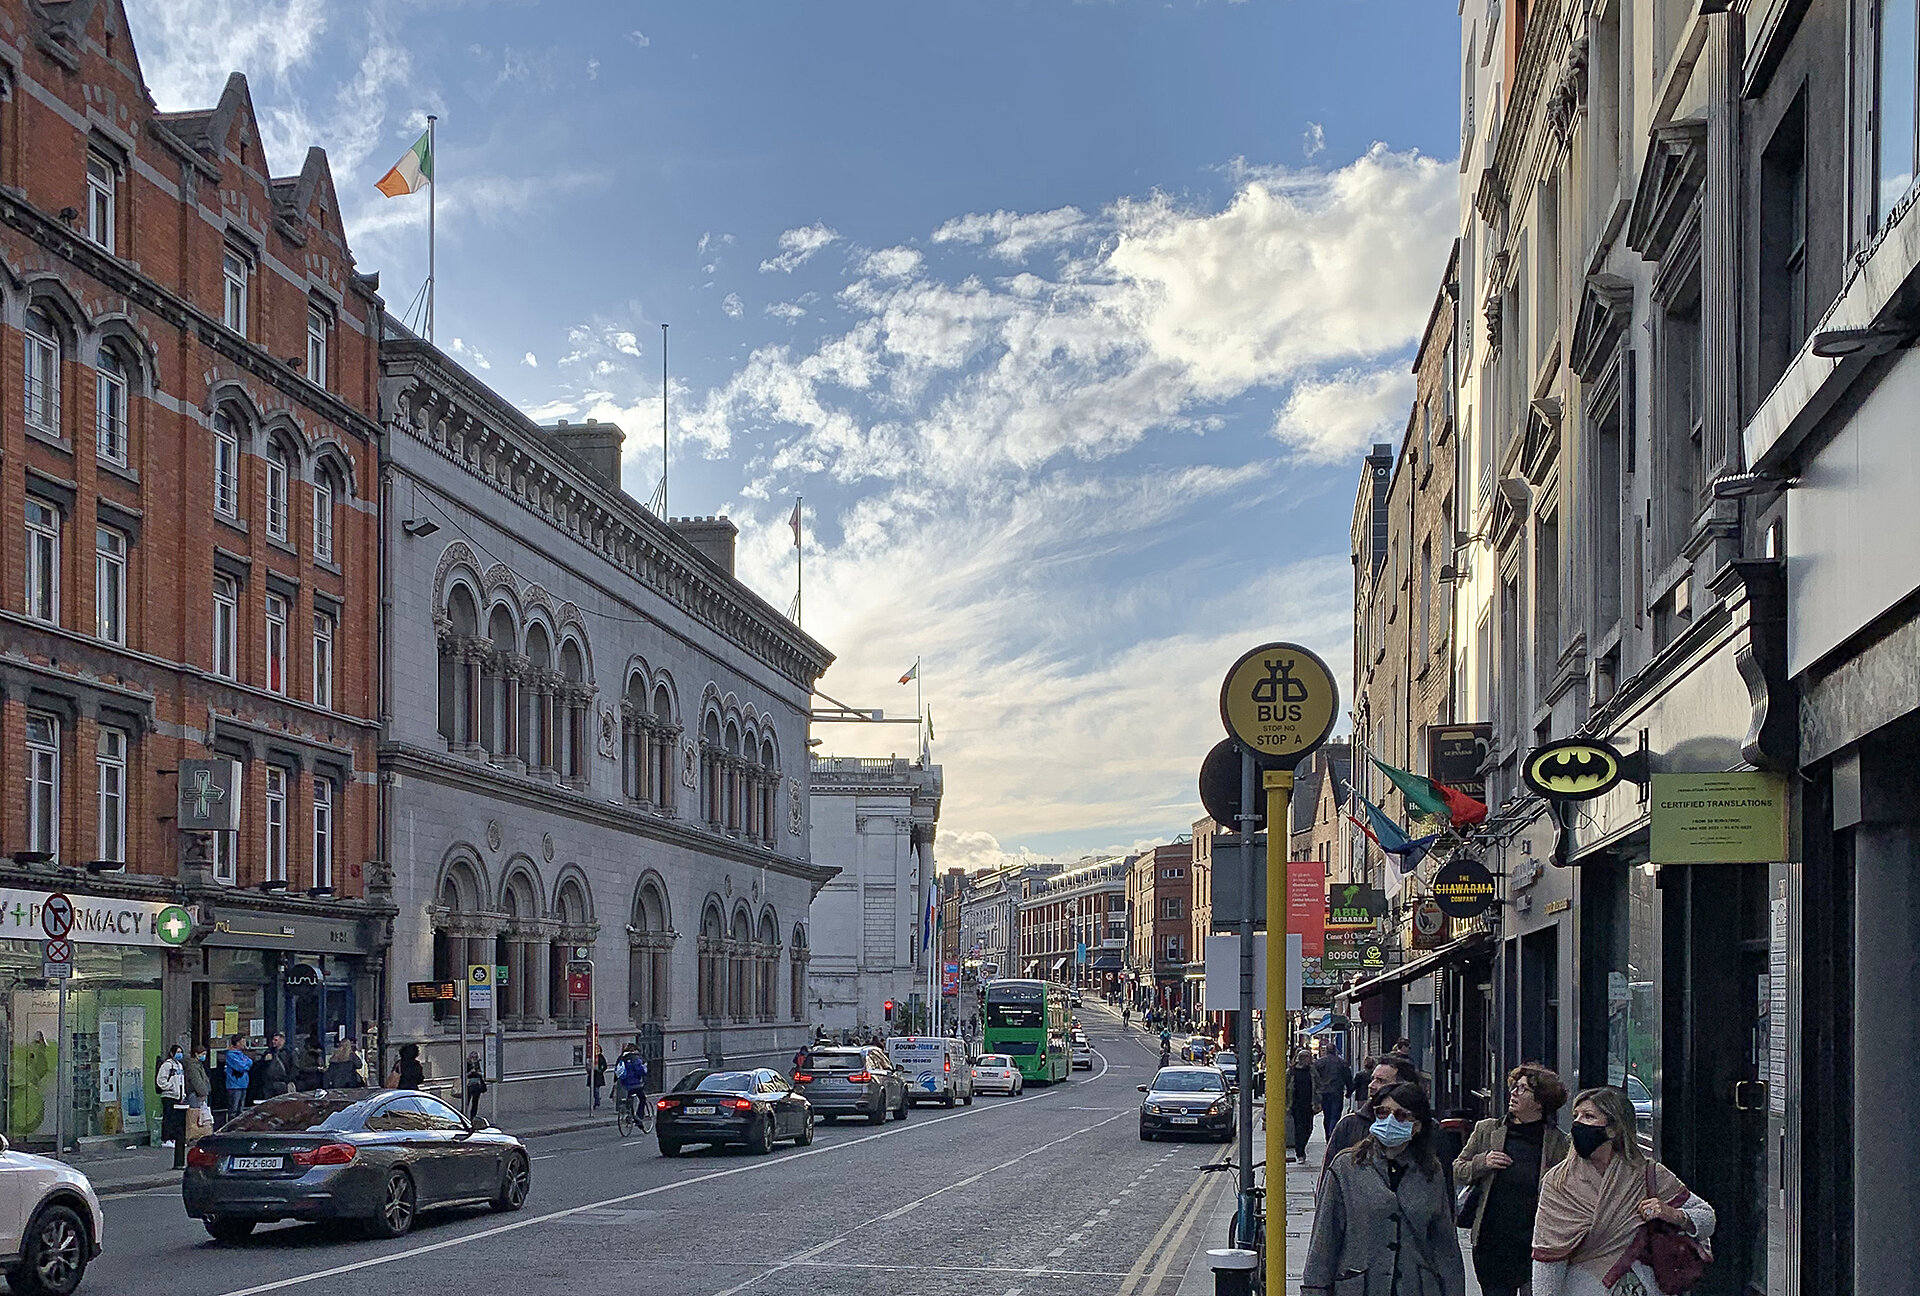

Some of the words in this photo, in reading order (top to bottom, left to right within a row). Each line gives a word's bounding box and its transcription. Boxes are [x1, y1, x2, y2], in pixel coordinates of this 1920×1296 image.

[1258, 705, 1303, 722] BUS
[1257, 735, 1287, 745] STOP
[1294, 735, 1303, 744] A
[1661, 801, 1705, 809] CERTIFIED
[1707, 799, 1773, 808] TRANSLATIONS
[1435, 883, 1493, 894] SHAWARMA
[1333, 908, 1369, 917] ABRA
[30, 903, 143, 934] PRMACY
[287, 974, 318, 985] umi
[239, 1159, 277, 1169] 172-C-6130
